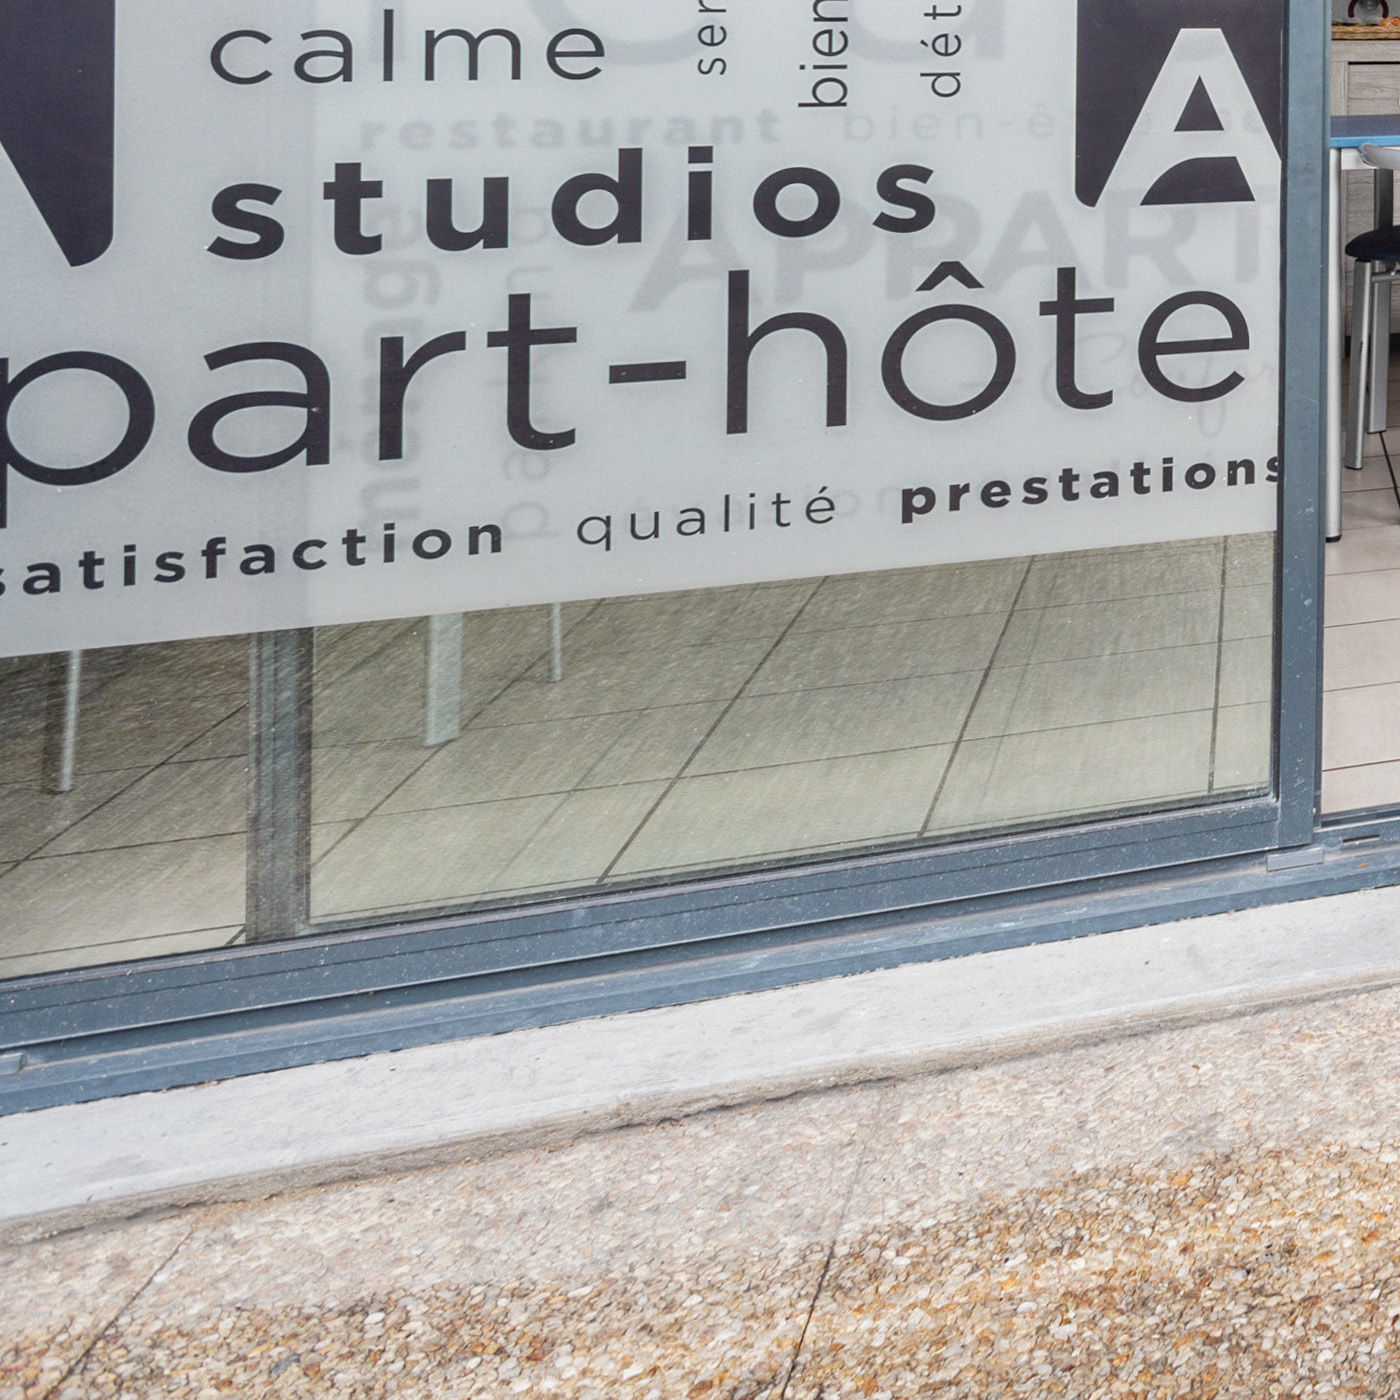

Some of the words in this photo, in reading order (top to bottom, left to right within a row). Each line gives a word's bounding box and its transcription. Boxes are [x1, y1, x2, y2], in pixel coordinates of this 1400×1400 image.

[210, 9, 605, 85] calme
[205, 145, 937, 261] studios
[0, 522, 504, 596] atisfaction
[577, 486, 835, 551] qualité
